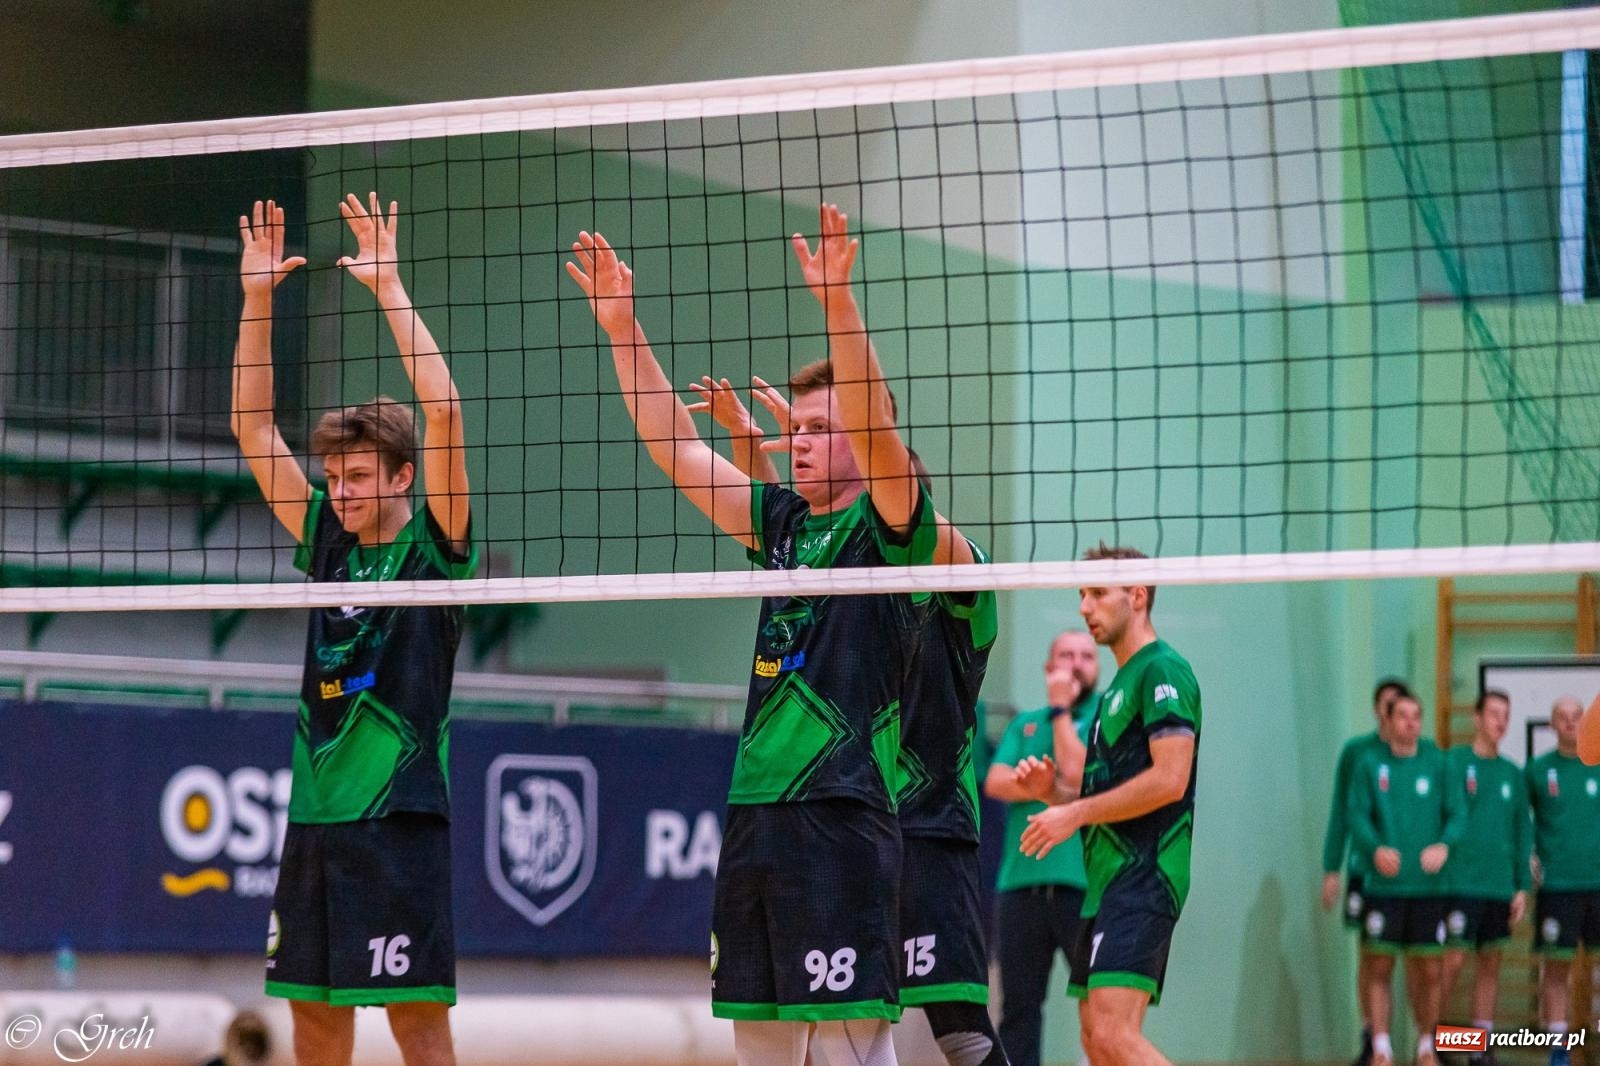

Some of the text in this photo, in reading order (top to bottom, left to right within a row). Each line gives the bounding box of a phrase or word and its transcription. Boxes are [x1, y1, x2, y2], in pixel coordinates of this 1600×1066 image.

[368, 934, 411, 977] 16
[804, 947, 857, 992] 98
[904, 934, 936, 977] 13
